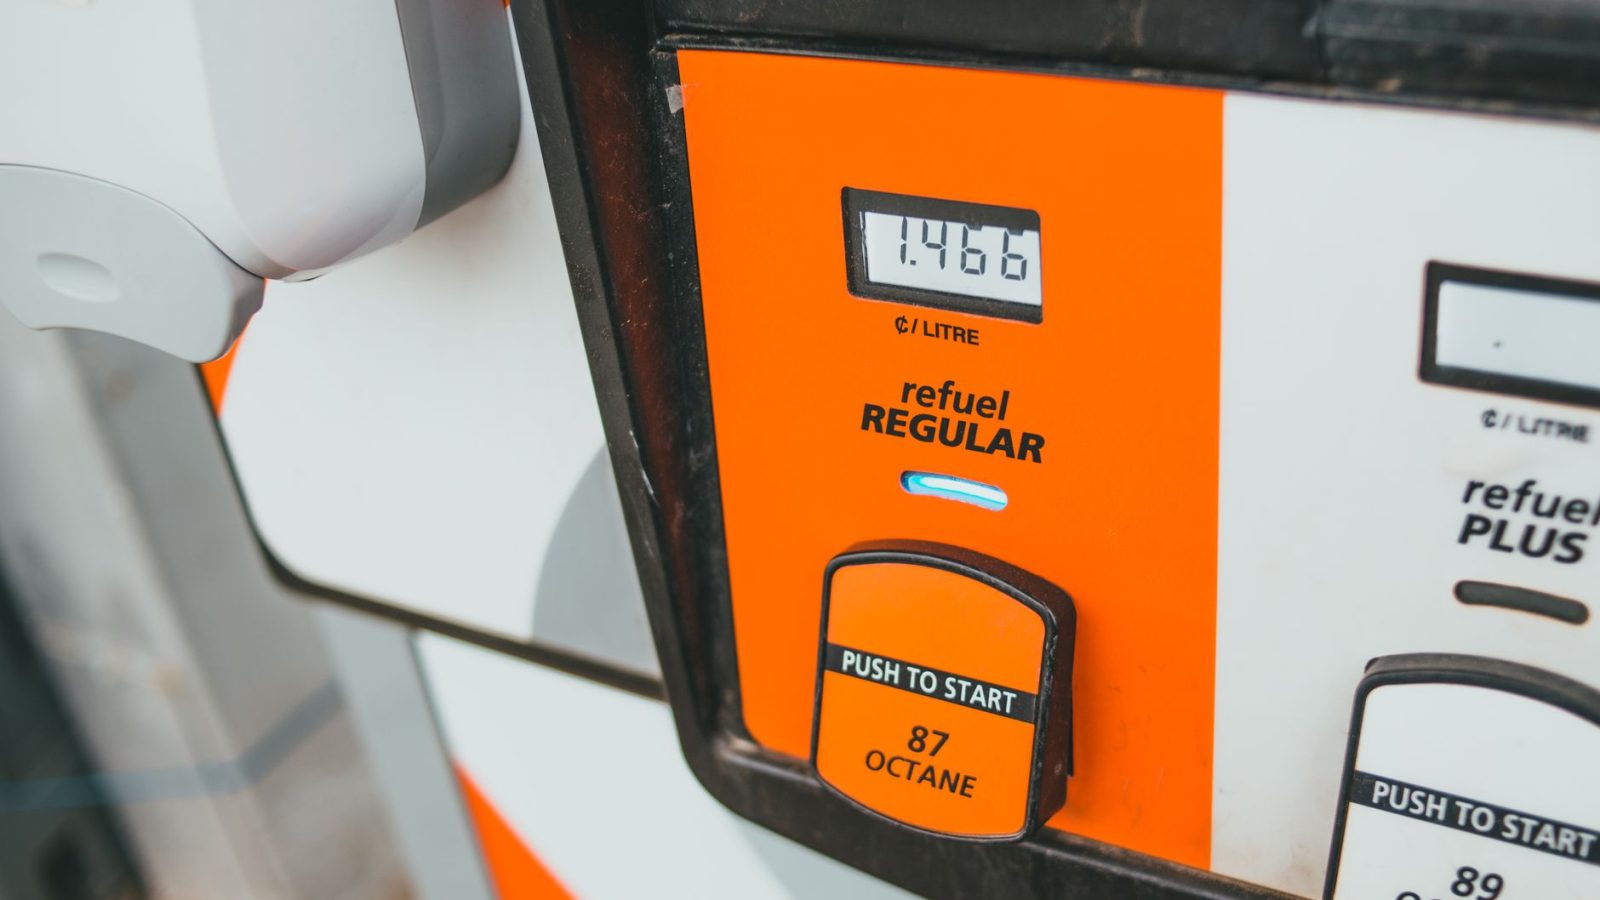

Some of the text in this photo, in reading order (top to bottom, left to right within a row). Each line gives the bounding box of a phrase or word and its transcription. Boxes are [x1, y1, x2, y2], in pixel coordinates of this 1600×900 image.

[899, 215, 1027, 281] 1.466
[923, 320, 979, 346] LITRE
[901, 380, 1010, 421] refuel
[860, 403, 1046, 464] REGULAR
[1518, 415, 1590, 443] LITRE
[1457, 513, 1588, 564] PLUS
[842, 650, 1017, 714] PUSH TO START
[907, 725, 950, 758] 87
[865, 749, 977, 798] OCTANE
[1372, 780, 1597, 859] PUSH TO START
[1450, 866, 1504, 900] 89
